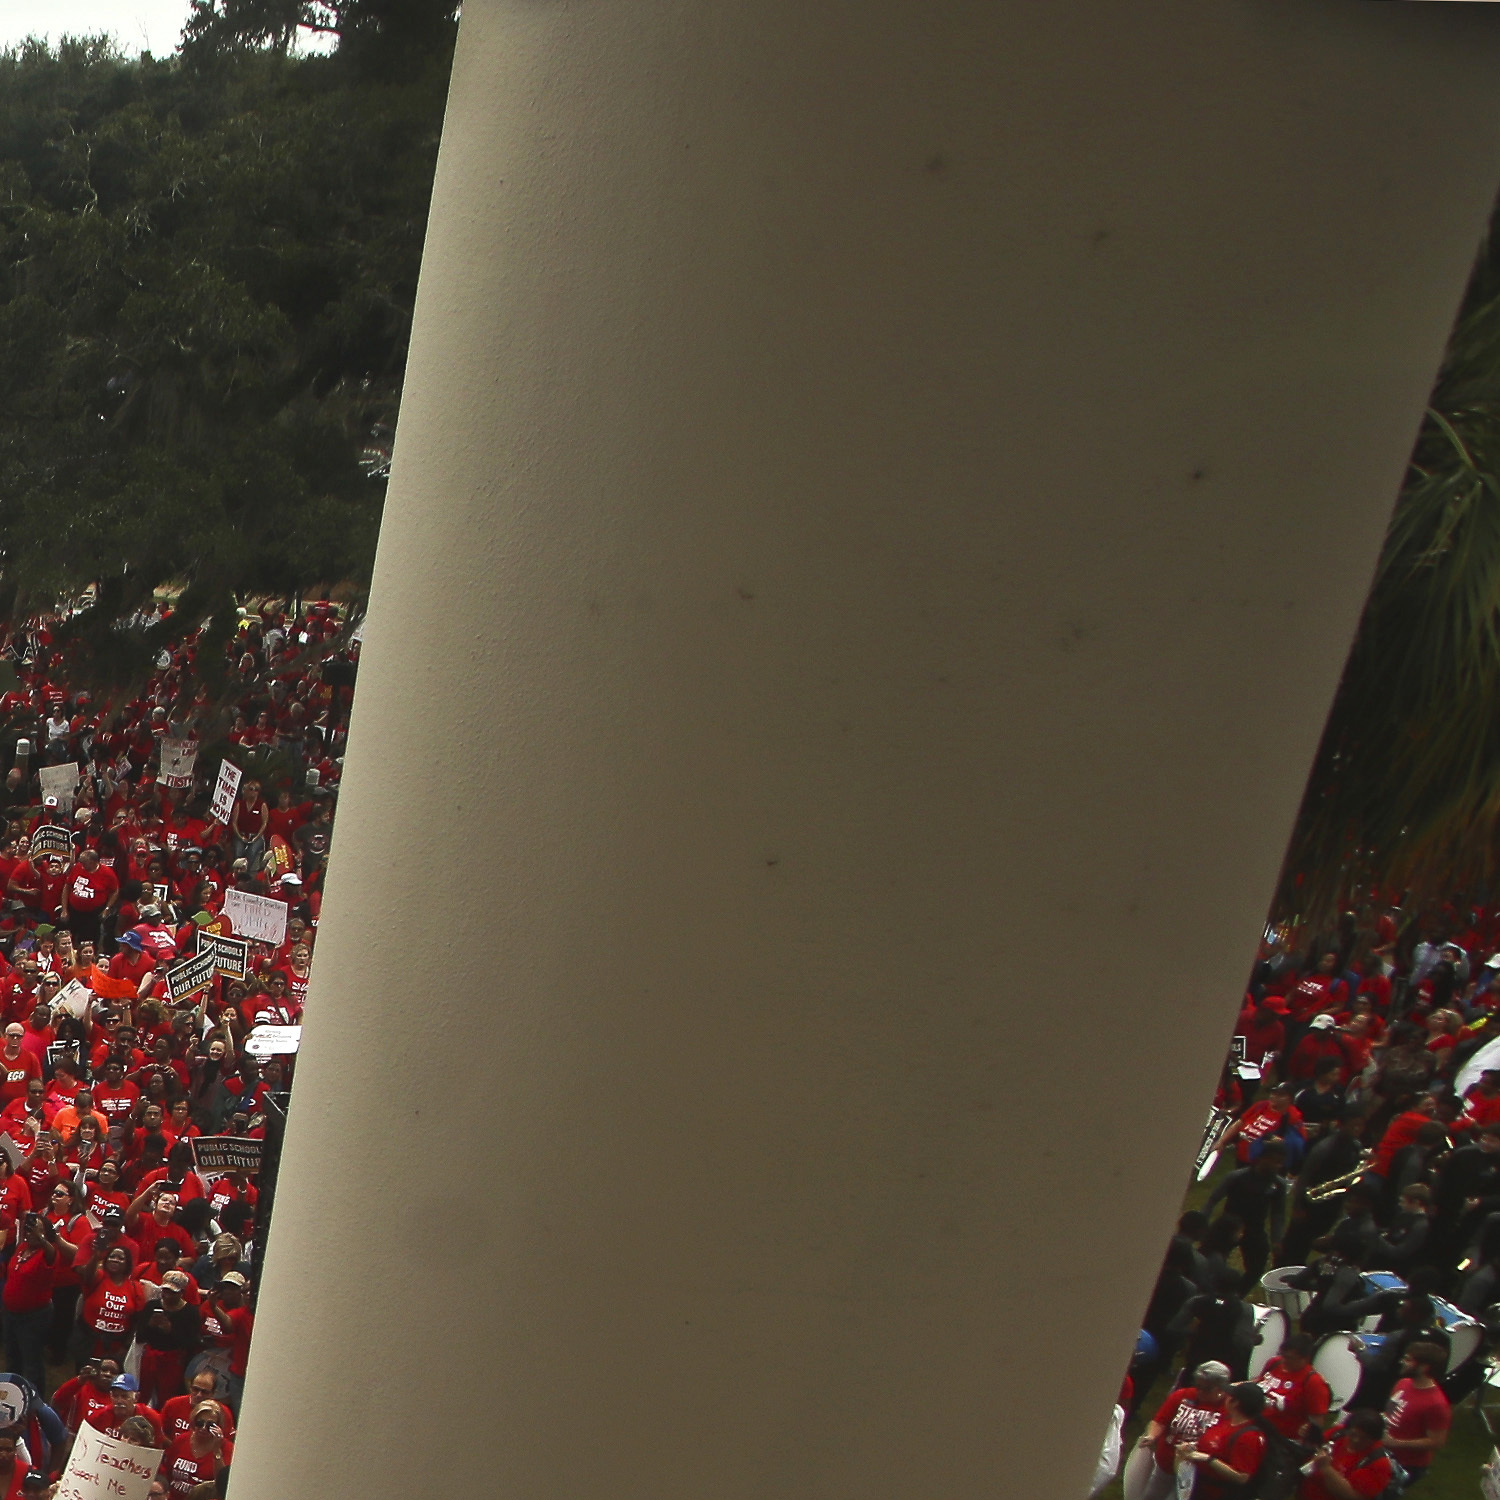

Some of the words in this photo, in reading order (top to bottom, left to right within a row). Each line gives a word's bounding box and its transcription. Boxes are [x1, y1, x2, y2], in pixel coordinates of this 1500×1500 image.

[219, 778, 237, 798] TIME
[218, 945, 243, 957] SCHOOLS
[214, 956, 242, 972] FUTURE
[171, 966, 193, 985] PUBLIC
[173, 980, 191, 996] OUR
[198, 1142, 229, 1153] PUBLIC
[201, 1154, 225, 1166] OUR
[104, 1291, 128, 1304] Fund
[106, 1300, 125, 1312] Our
[92, 1438, 153, 1480] Teachers
[174, 1457, 199, 1473] FUND
[107, 1473, 127, 1496] Me
